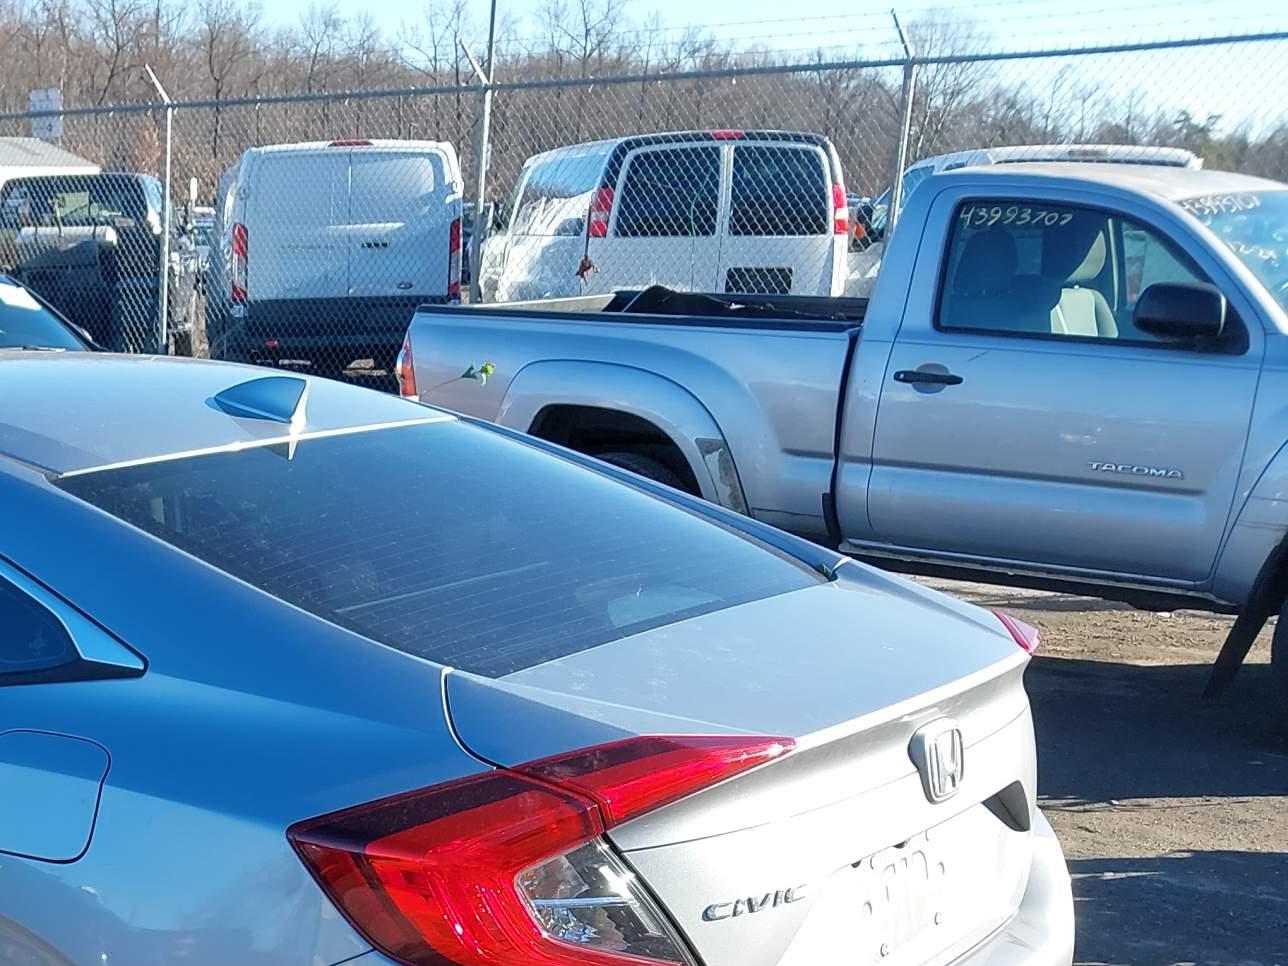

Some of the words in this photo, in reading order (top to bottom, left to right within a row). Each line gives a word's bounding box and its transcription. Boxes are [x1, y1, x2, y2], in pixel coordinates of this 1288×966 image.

[960, 206, 1073, 226] 43993707
[1087, 460, 1184, 480] TACOMA
[701, 883, 807, 922] CIVIC
